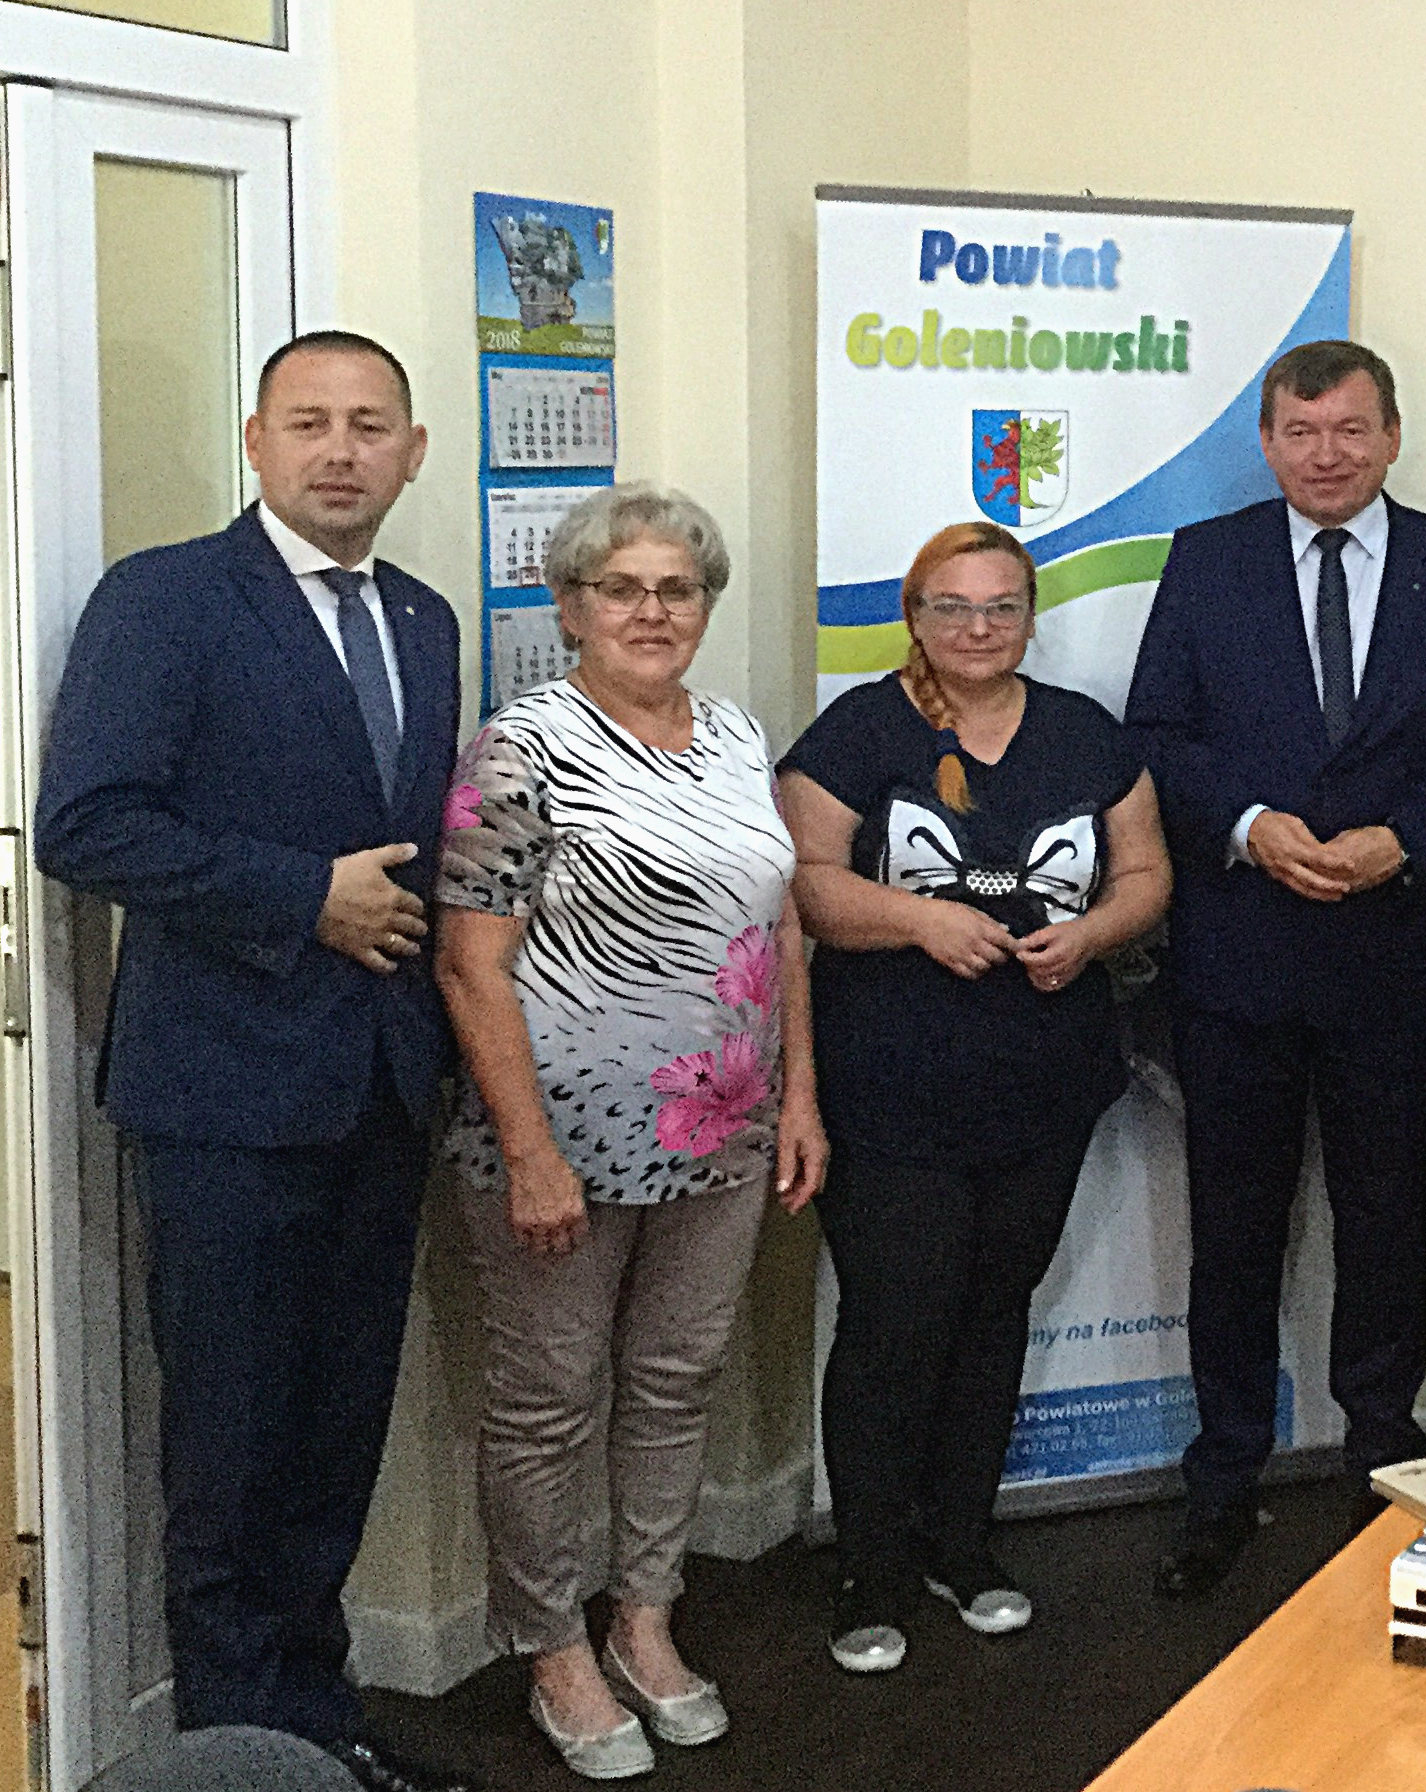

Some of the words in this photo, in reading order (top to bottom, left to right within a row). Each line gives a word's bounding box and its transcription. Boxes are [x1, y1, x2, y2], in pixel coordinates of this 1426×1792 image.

[920, 229, 1120, 290] Powiat
[487, 329, 521, 351] 2018
[846, 309, 1189, 373] Goleniowski
[1066, 1323, 1094, 1342] na
[1024, 1398, 1130, 1422] Powiatowe
[1135, 1396, 1151, 1409] w
